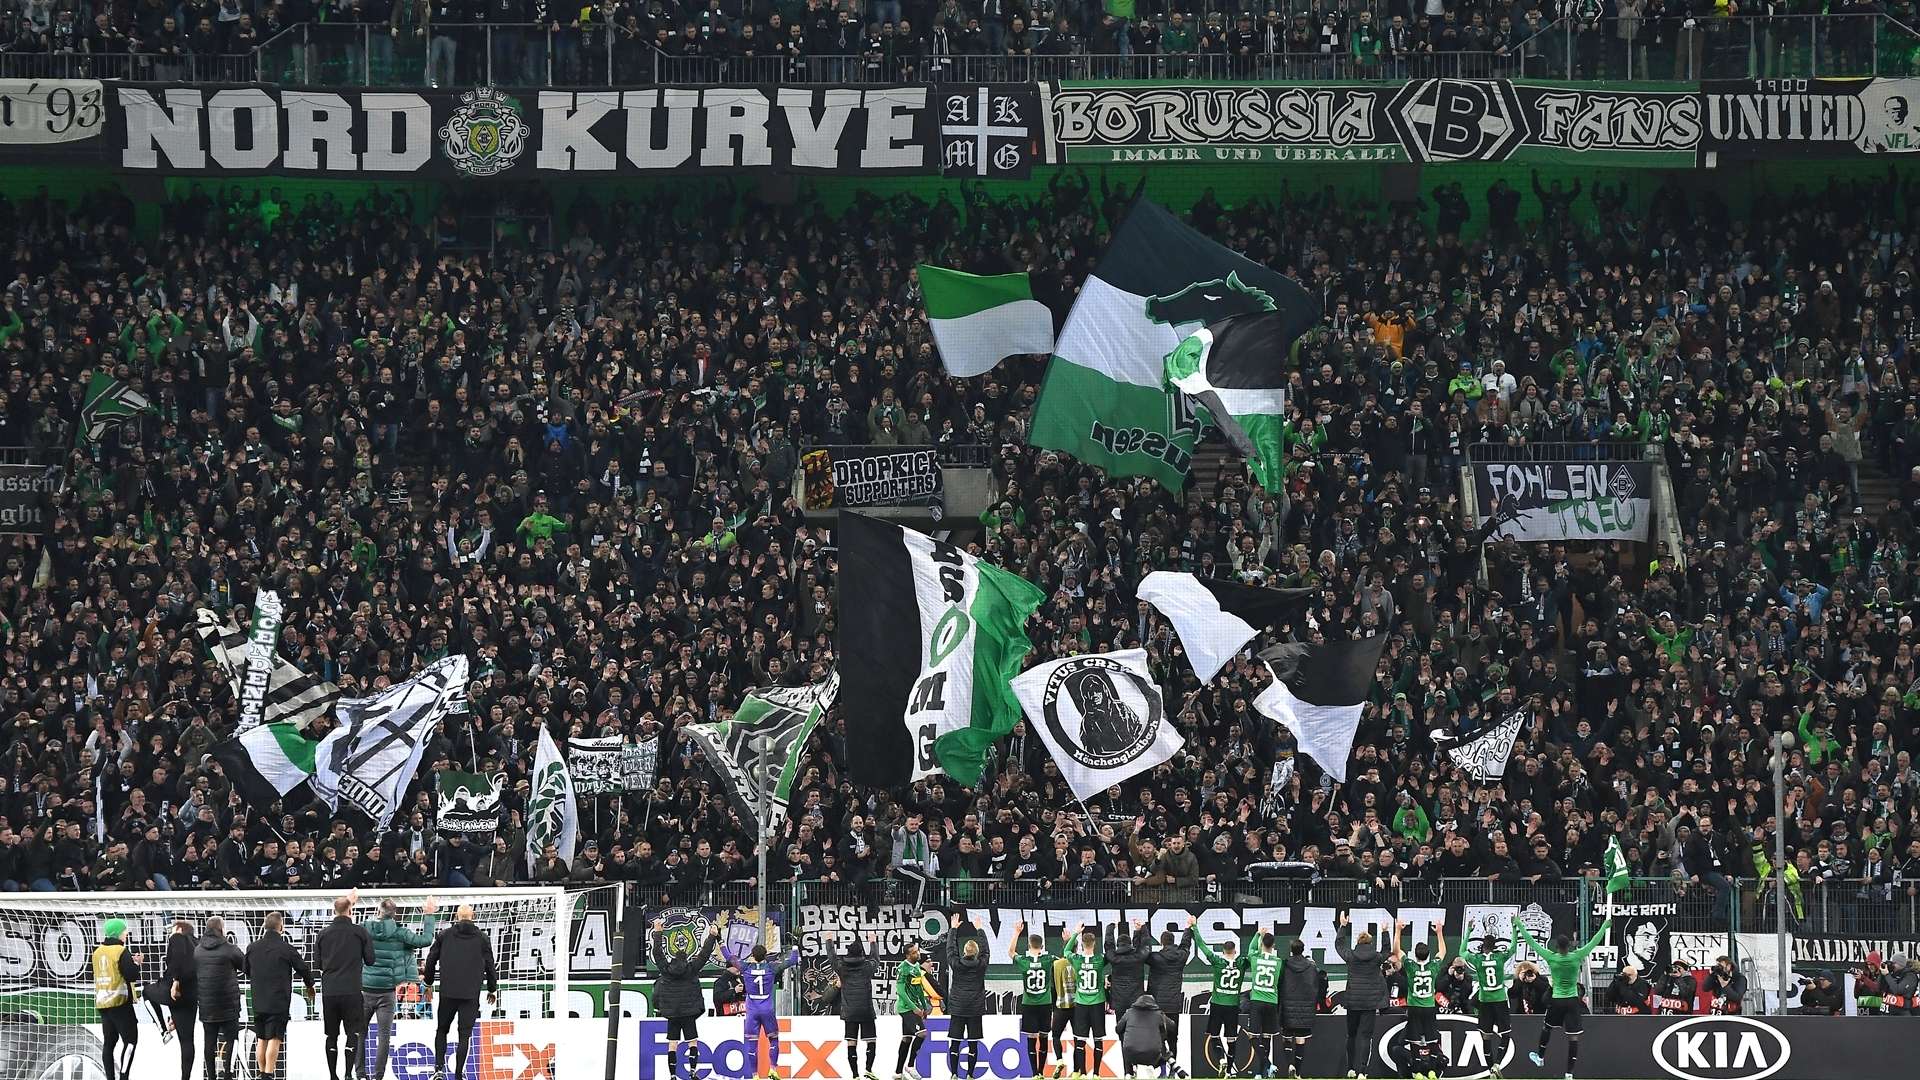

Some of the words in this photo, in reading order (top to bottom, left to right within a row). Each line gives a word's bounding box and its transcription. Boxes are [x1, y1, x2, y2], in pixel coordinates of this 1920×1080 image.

[118, 87, 432, 171] NORD
[536, 88, 927, 170] KURVE
[1050, 88, 1378, 147] BORUSSIA
[1535, 93, 1703, 150] FANS
[1706, 94, 1866, 141] UNITED
[1111, 148, 1202, 162] IMMER
[1216, 148, 1262, 161] UND
[1279, 146, 1397, 161] ÜBERALL!
[834, 450, 942, 488] DROPKICK
[1486, 464, 1608, 501] FOHLEN
[845, 475, 938, 505] SUPPORTERS
[1548, 497, 1636, 537] TREU
[1045, 662, 1078, 706] VITUS
[1073, 720, 1159, 767] Mönchengladbach
[754, 976, 764, 995] 1
[1026, 969, 1046, 990] 28
[1078, 969, 1098, 990] 30
[1220, 968, 1241, 989] 22
[1256, 966, 1276, 987] 25
[1413, 976, 1433, 995] 23
[1485, 967, 1497, 987] 8
[1676, 1031, 1768, 1068] KIA
